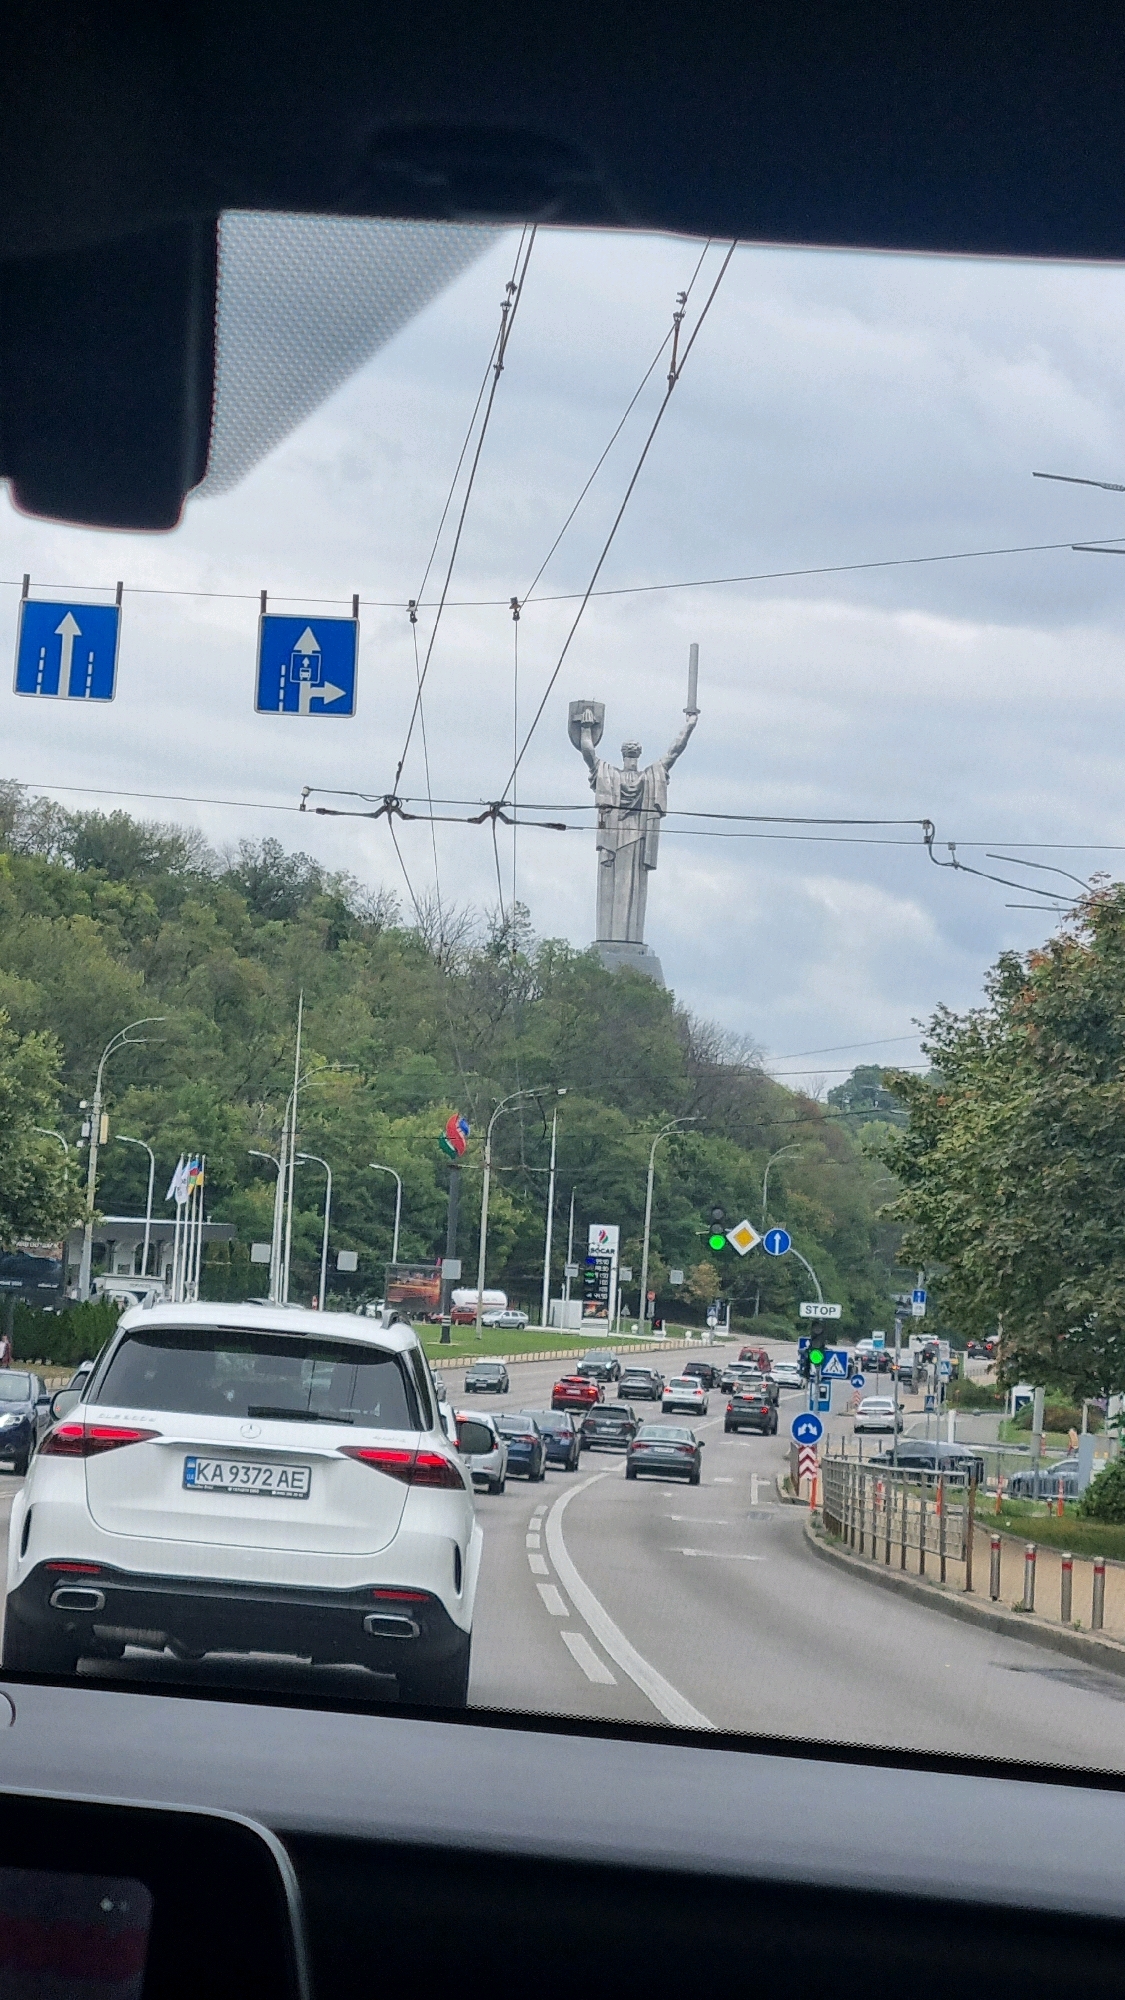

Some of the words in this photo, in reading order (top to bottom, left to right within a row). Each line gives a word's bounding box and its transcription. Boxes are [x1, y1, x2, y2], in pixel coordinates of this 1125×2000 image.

[805, 1305, 836, 1316] STOP
[197, 1462, 224, 1482] KA
[229, 1465, 273, 1487] 9372
[276, 1469, 305, 1490] AE
